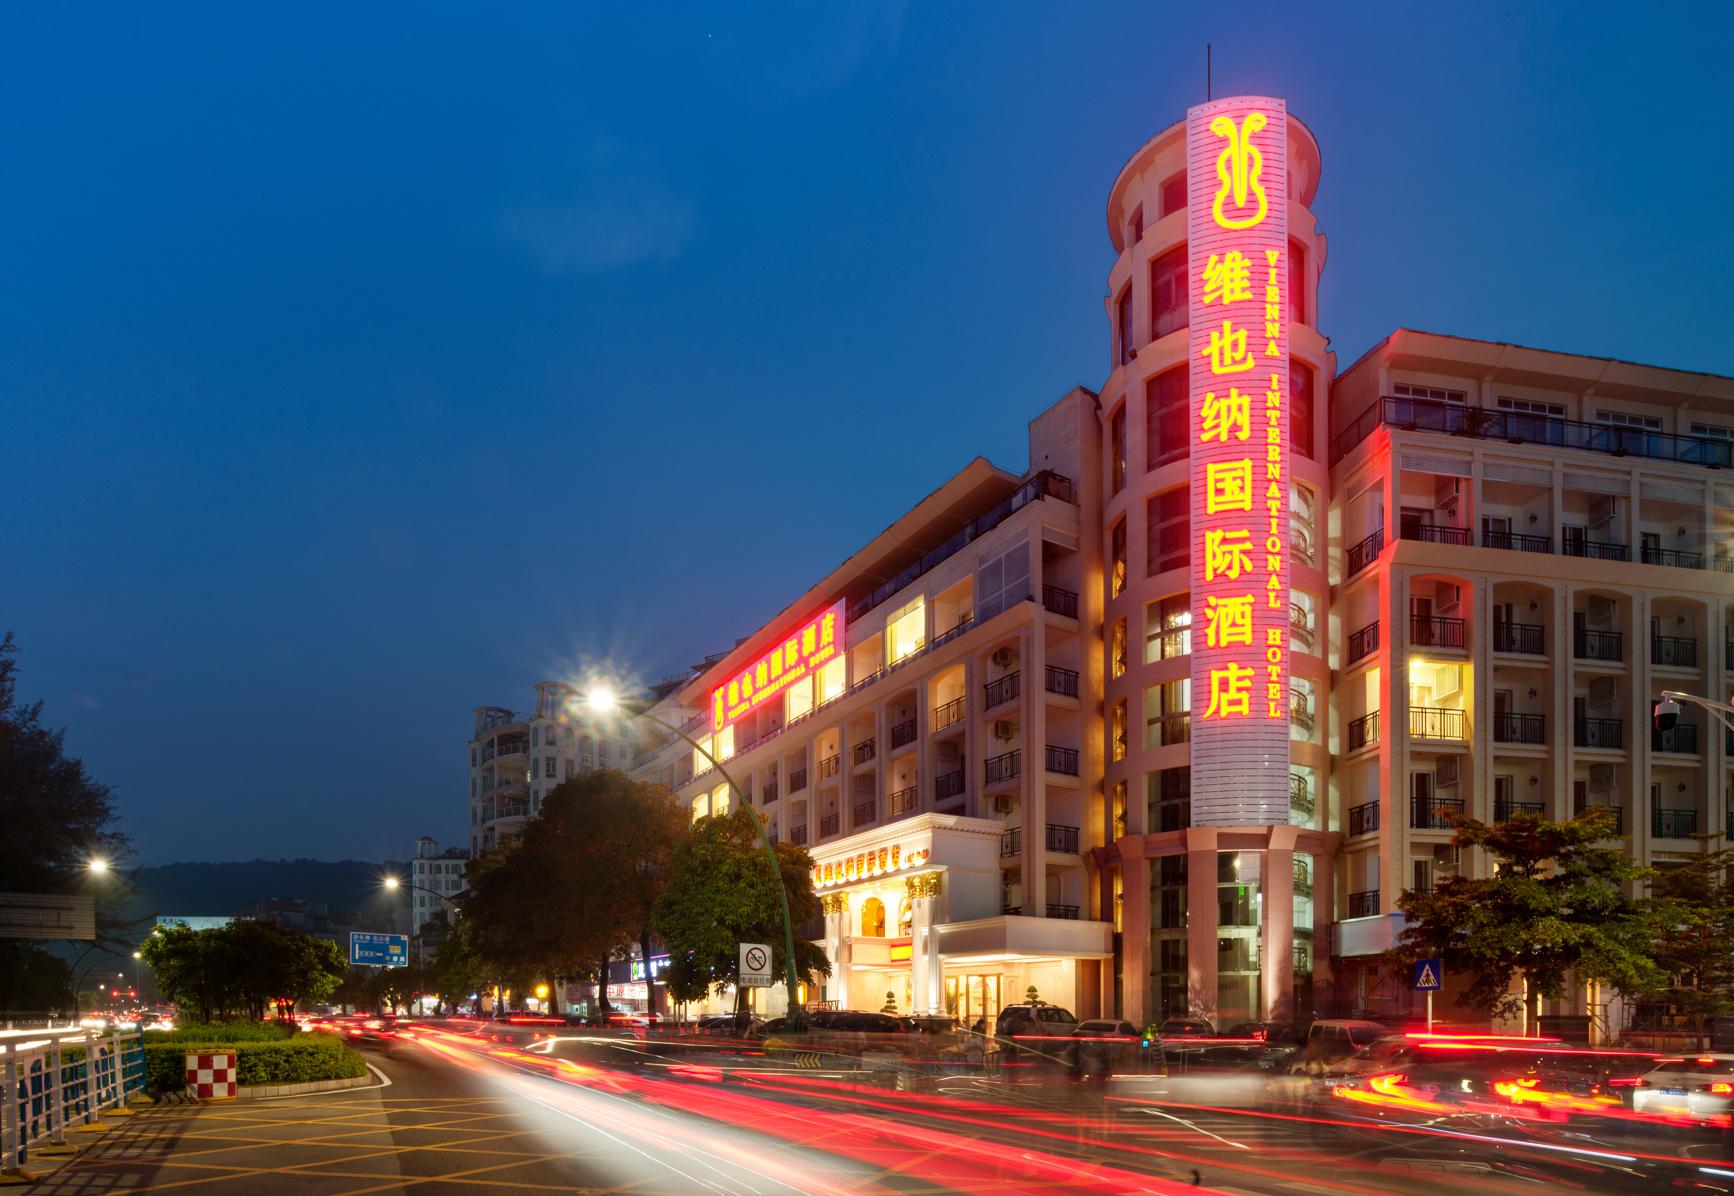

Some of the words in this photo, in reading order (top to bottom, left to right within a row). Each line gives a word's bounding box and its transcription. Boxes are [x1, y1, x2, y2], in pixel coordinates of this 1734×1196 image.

[1265, 249, 1281, 358] VIENNA
[1200, 250, 1256, 719] 维也纳国际酒店
[1265, 373, 1281, 609] INTERNATIONAL
[726, 612, 836, 708] 维也纳国际酒店
[1266, 628, 1282, 718] HOTEL
